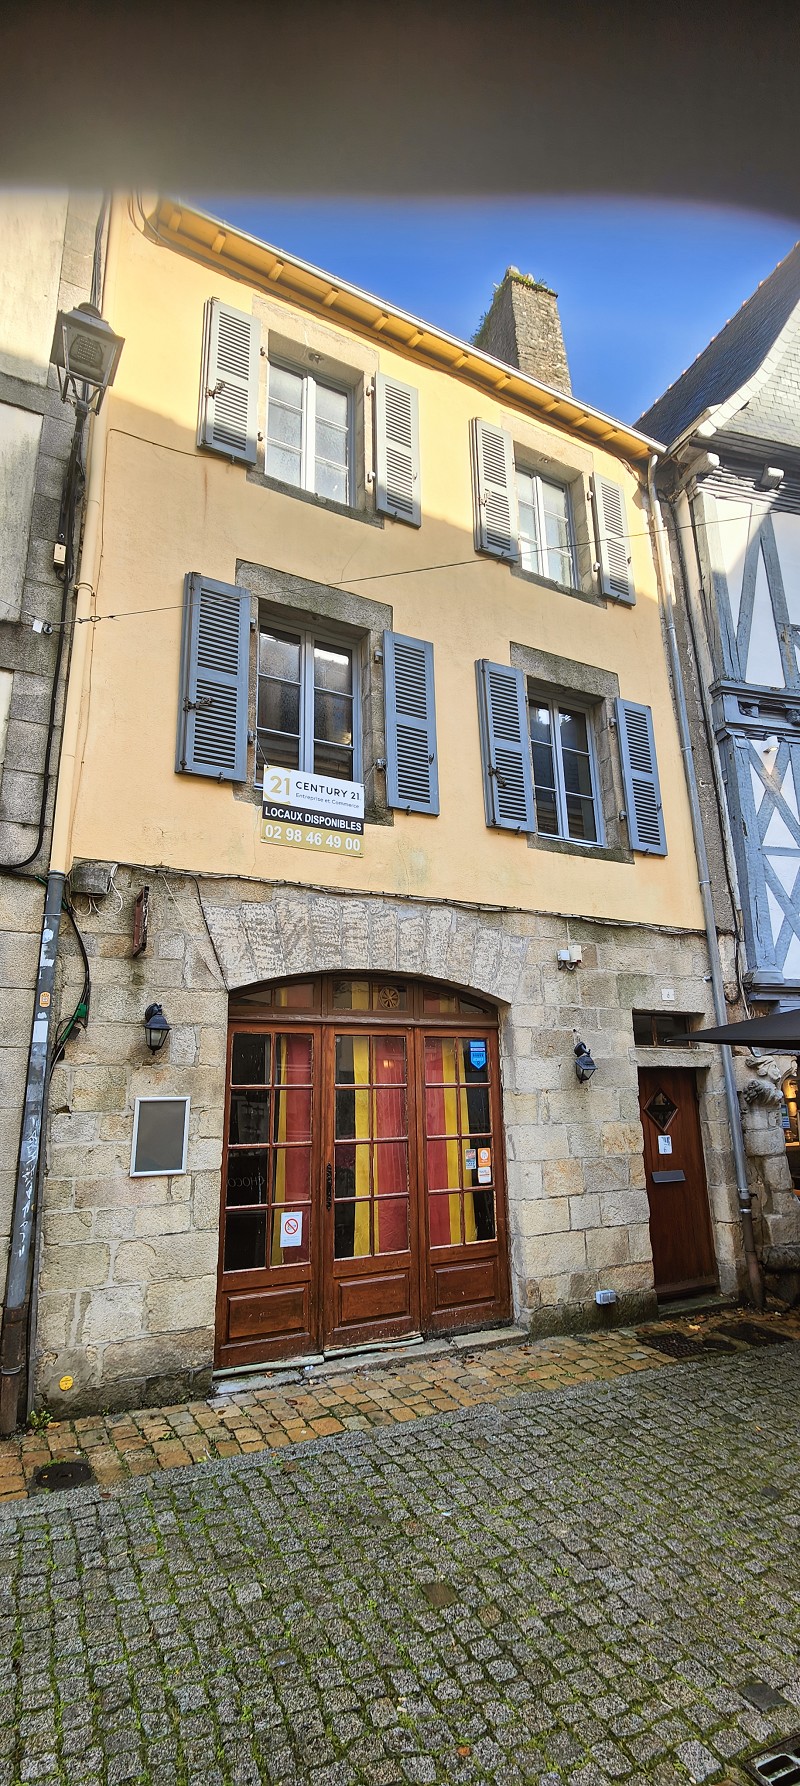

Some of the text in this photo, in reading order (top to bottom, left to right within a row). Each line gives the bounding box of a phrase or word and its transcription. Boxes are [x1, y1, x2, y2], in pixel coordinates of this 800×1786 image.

[270, 775, 290, 796] 21
[295, 781, 360, 801] CENTURY 21
[295, 793, 324, 802] Entreprise
[331, 799, 360, 809] Commerce
[265, 806, 362, 832] LOCAUX DISPONIBLES
[265, 824, 361, 851] 02 98 46 49 00
